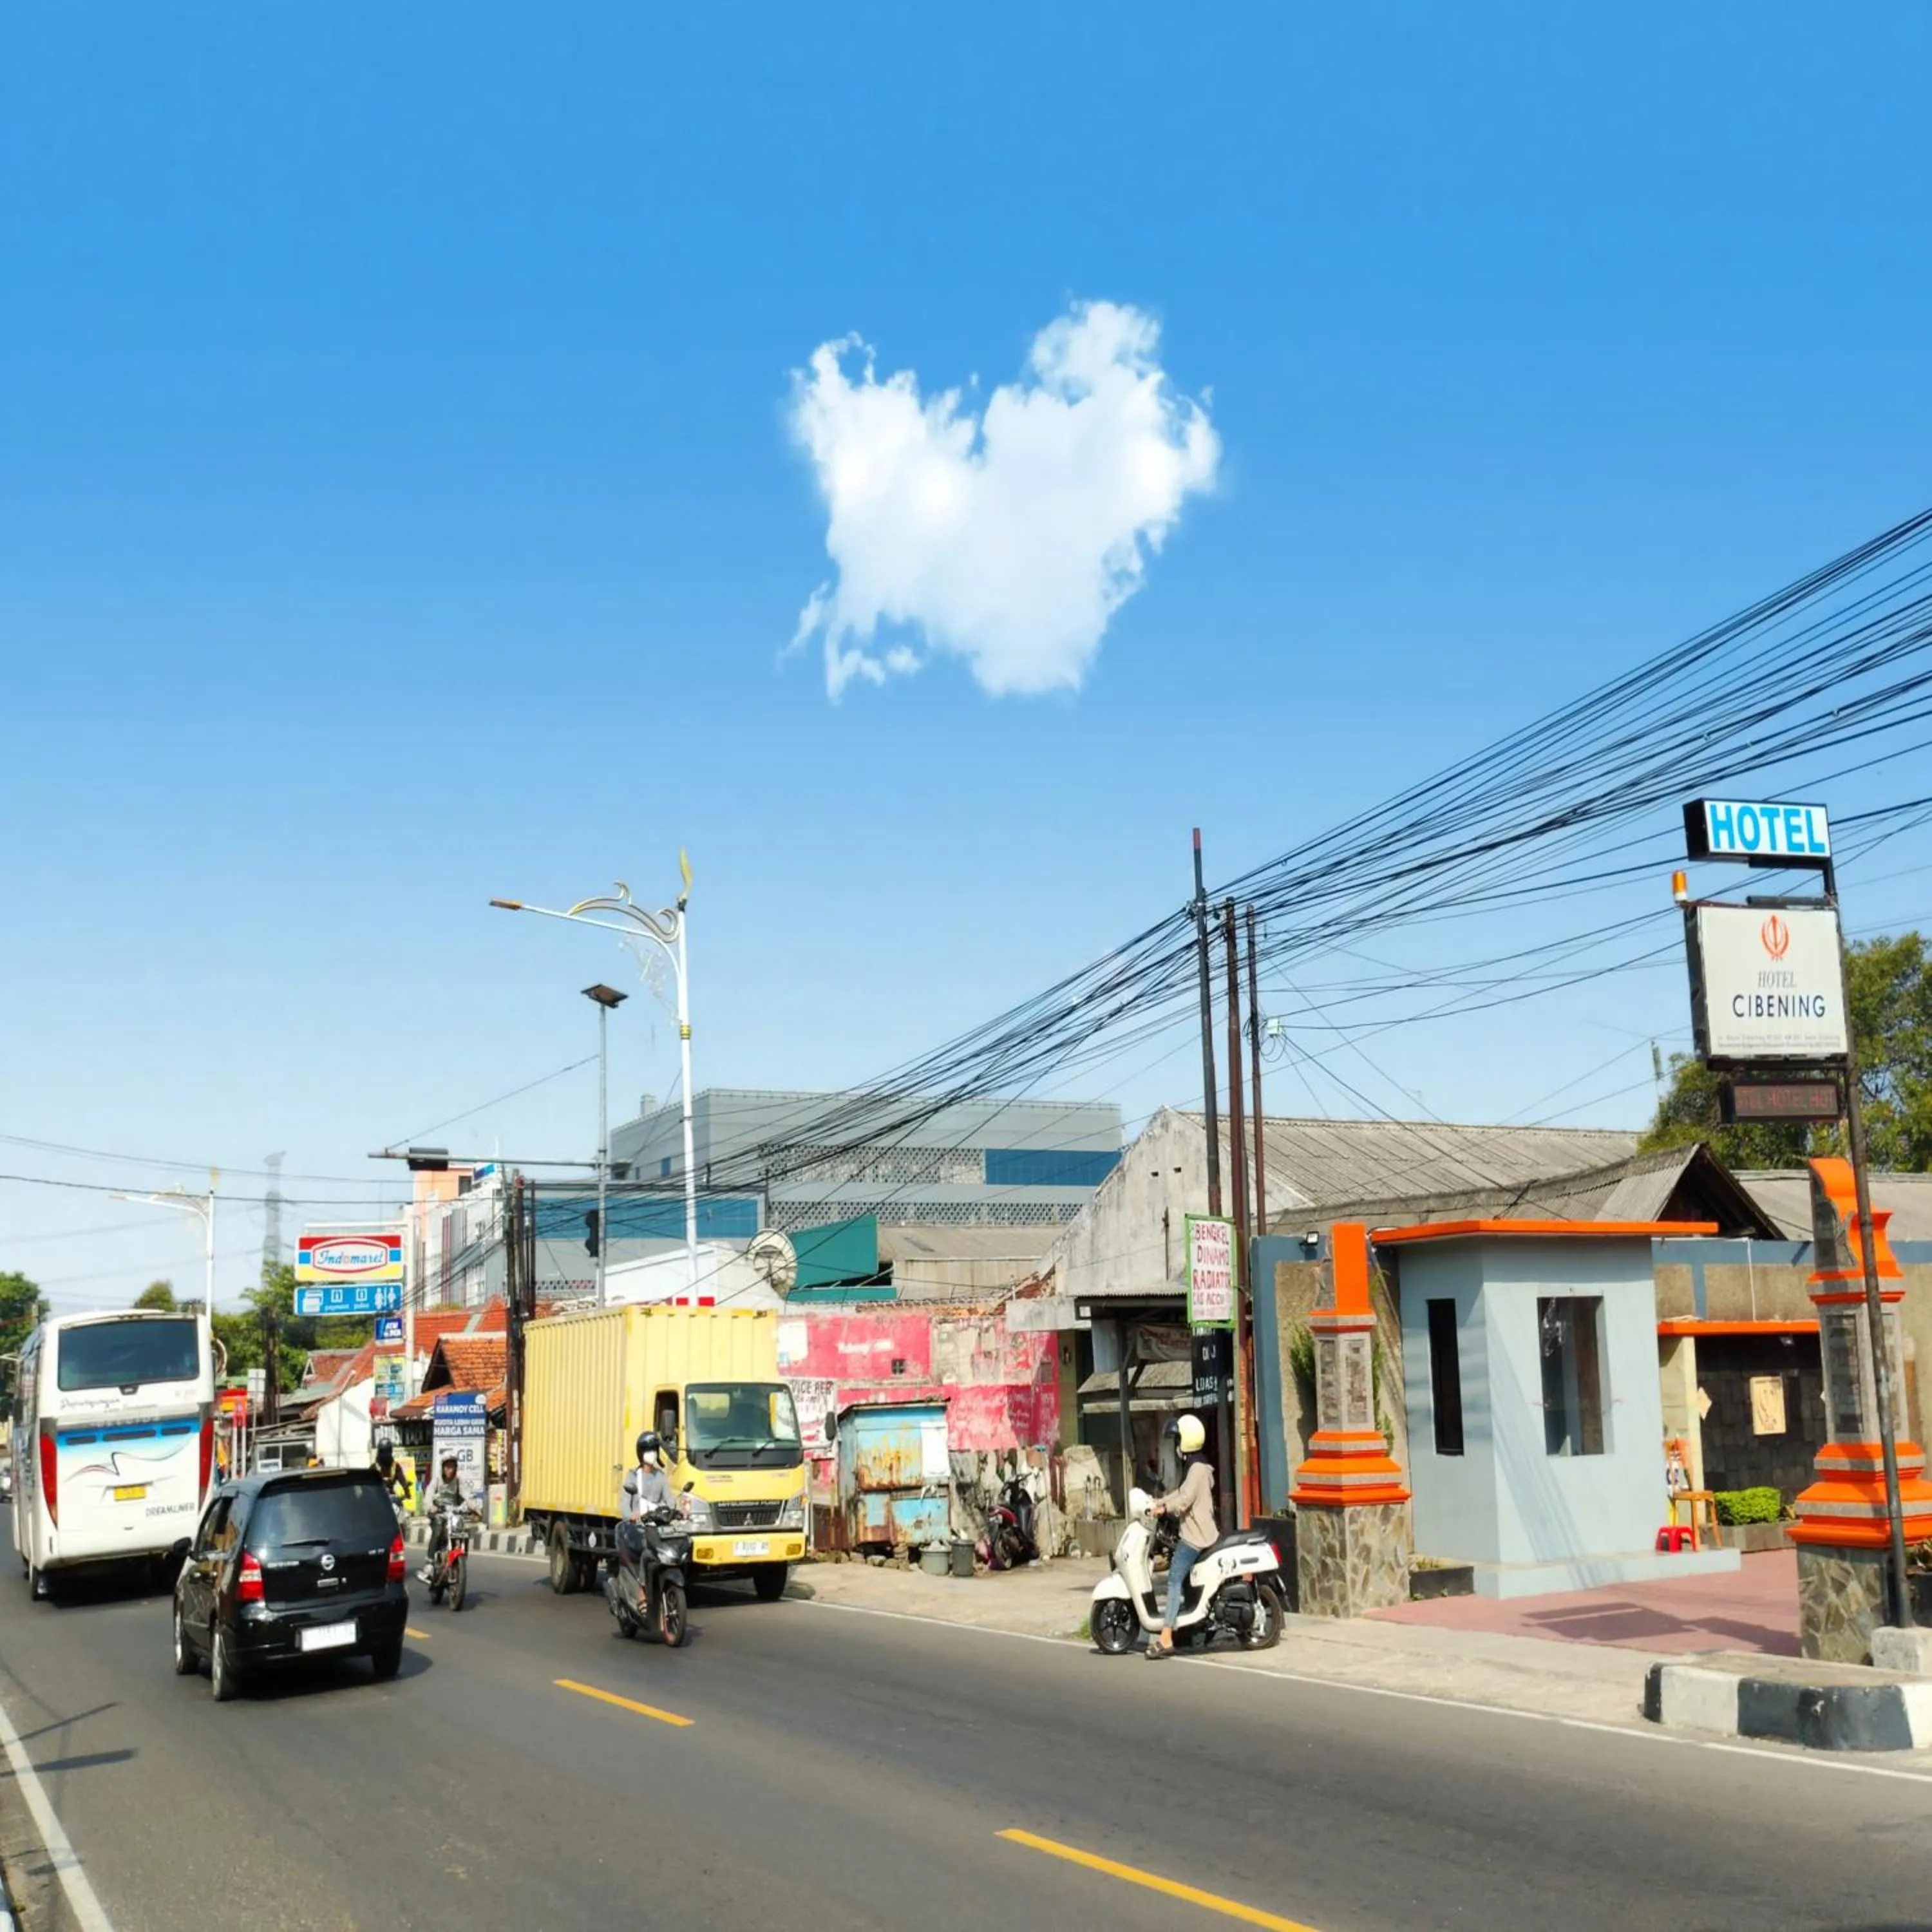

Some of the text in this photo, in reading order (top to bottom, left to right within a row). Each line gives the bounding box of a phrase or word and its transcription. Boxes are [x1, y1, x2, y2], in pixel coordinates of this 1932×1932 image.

[1709, 804, 1826, 853] HOTEL
[1757, 970, 1797, 989] HOTEL
[1732, 994, 1826, 1018] CIBENING
[1195, 1224, 1229, 1245] BENGKEL
[318, 1250, 384, 1265] Indomaret
[1197, 1245, 1229, 1266] DINAMO
[146, 1502, 195, 1517] DREAMLINER
